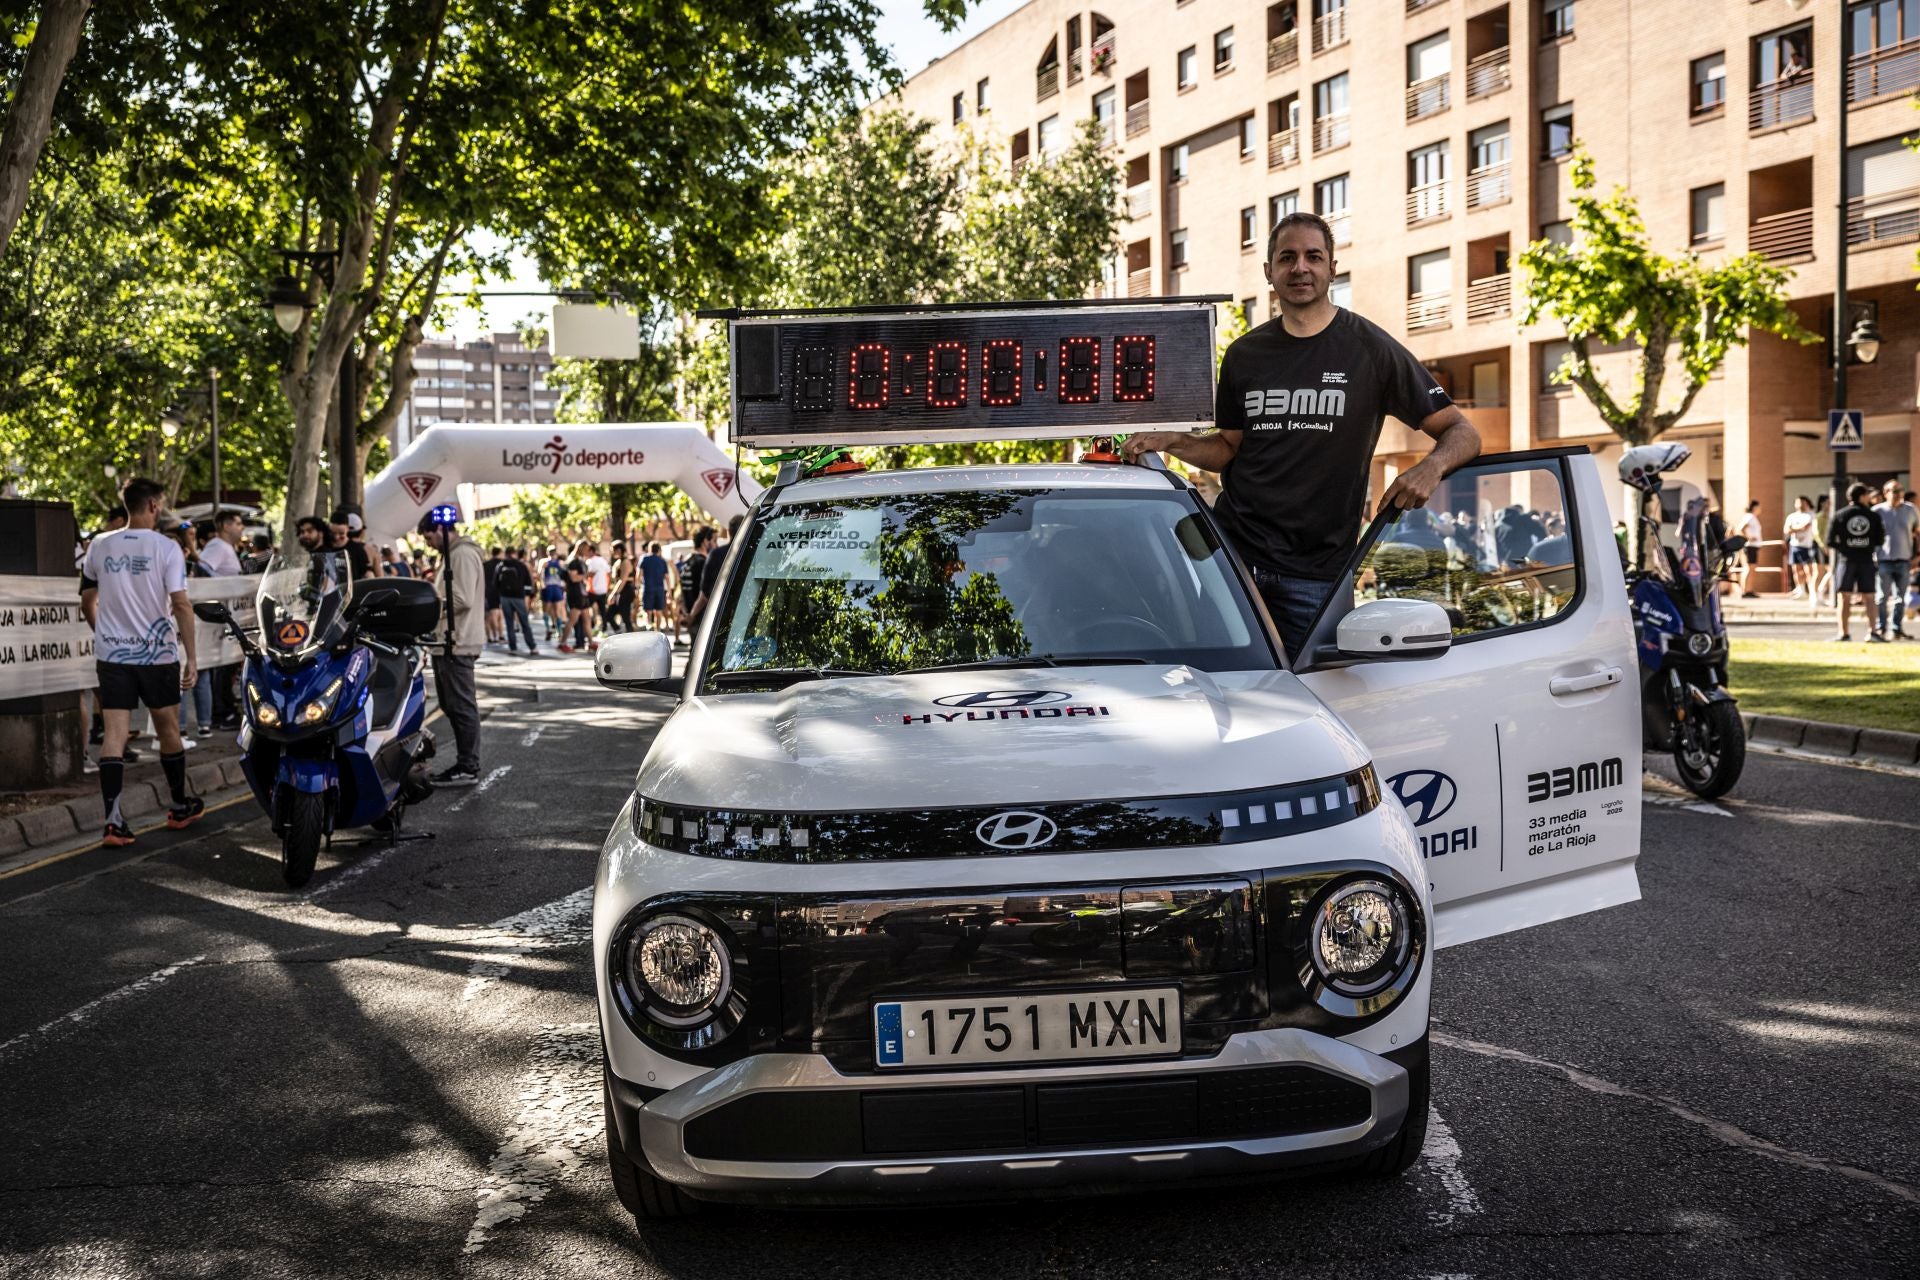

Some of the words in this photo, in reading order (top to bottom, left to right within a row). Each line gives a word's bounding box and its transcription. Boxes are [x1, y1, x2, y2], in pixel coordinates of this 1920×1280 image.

[1261, 422, 1283, 431] RIOJA
[575, 448, 645, 470] deporte
[766, 540, 871, 550] AUTORIZADO
[39, 607, 71, 624] RIOJA
[40, 642, 72, 661] RIOJA
[902, 706, 1110, 725] HYUNDAI
[1600, 799, 1624, 809] Logroño
[1606, 806, 1623, 816] 2025
[1528, 816, 1546, 830] 33
[1549, 809, 1587, 826] media
[1528, 823, 1581, 843] maratón
[1528, 844, 1545, 856] de
[1547, 841, 1563, 852] La
[1566, 833, 1596, 848] Rioja
[921, 1004, 1040, 1056] 1751
[1068, 997, 1168, 1049] MXN
[885, 1040, 897, 1054] E
